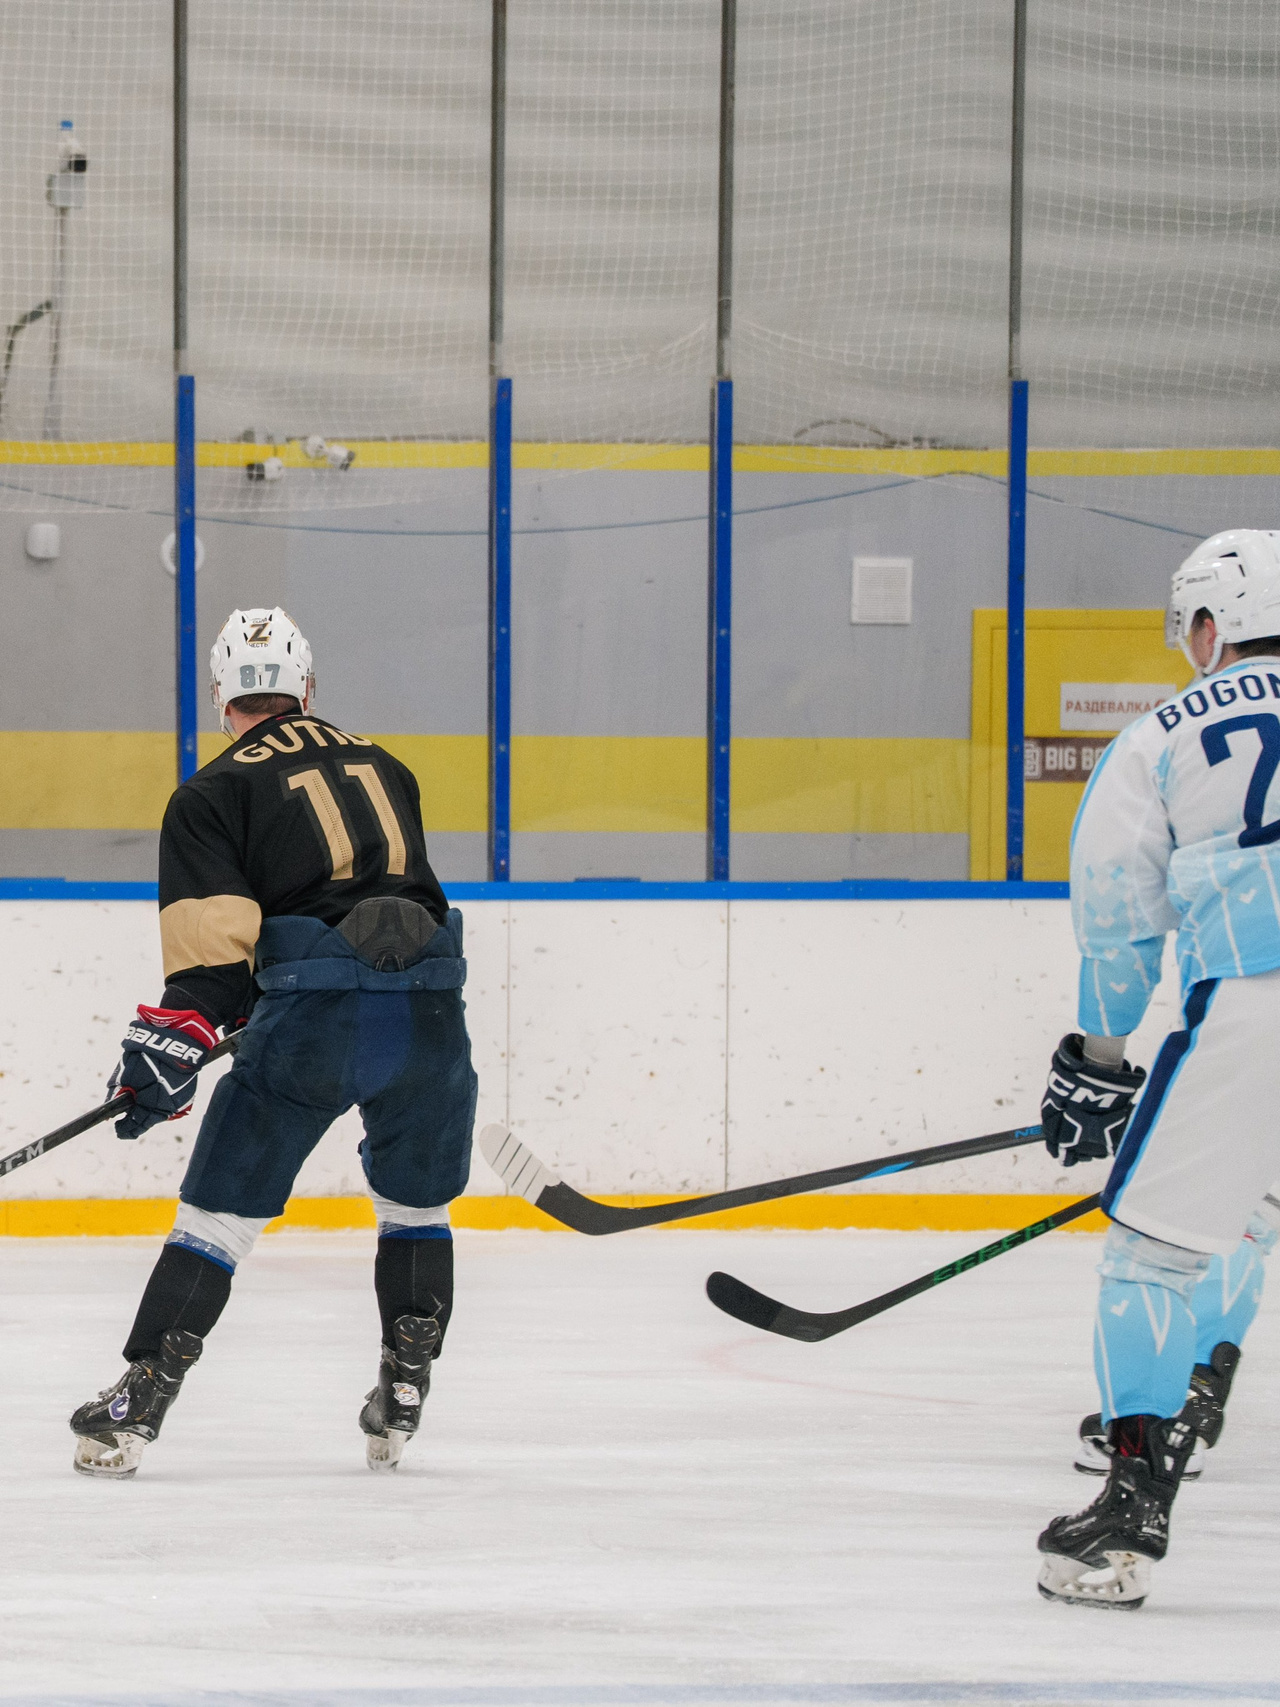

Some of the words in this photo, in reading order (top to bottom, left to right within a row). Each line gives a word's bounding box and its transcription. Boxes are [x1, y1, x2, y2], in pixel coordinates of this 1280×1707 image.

[240, 664, 280, 688] 87
[1065, 700, 1152, 715] РАЗДЕВАЛКА
[1044, 746, 1077, 771] BIG
[287, 763, 406, 880] 11
[125, 1025, 204, 1065] BAUER
